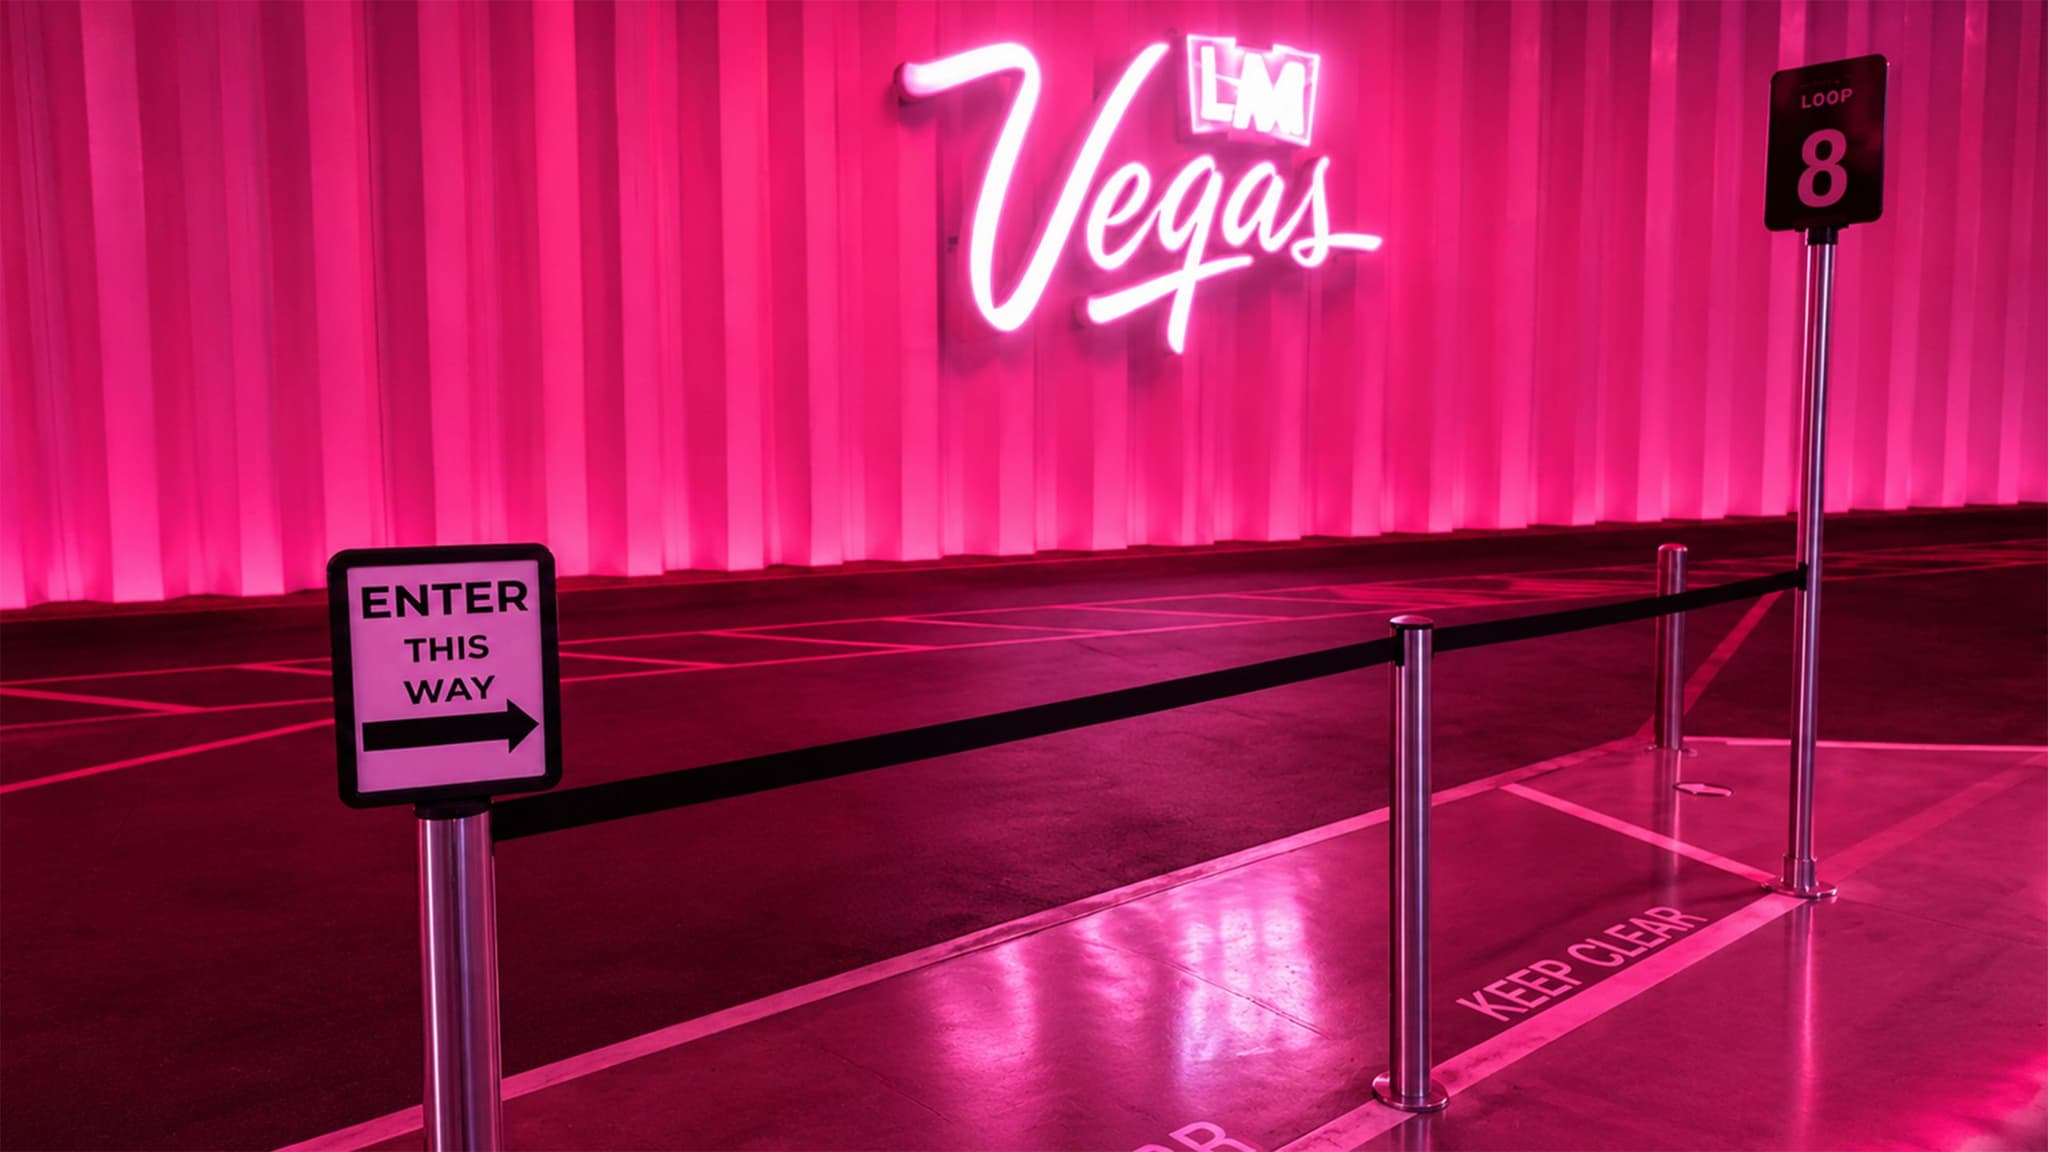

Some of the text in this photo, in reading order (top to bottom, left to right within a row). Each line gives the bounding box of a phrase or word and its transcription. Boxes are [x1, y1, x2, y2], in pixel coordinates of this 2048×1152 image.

[1801, 88, 1853, 109] LOOP
[1797, 128, 1848, 208] 8
[903, 42, 1383, 355] Vegas
[361, 580, 528, 619] ENTER
[404, 634, 490, 663] THIS
[403, 675, 495, 705] WAY
[1456, 906, 1708, 1022] KEEP CLEAR
